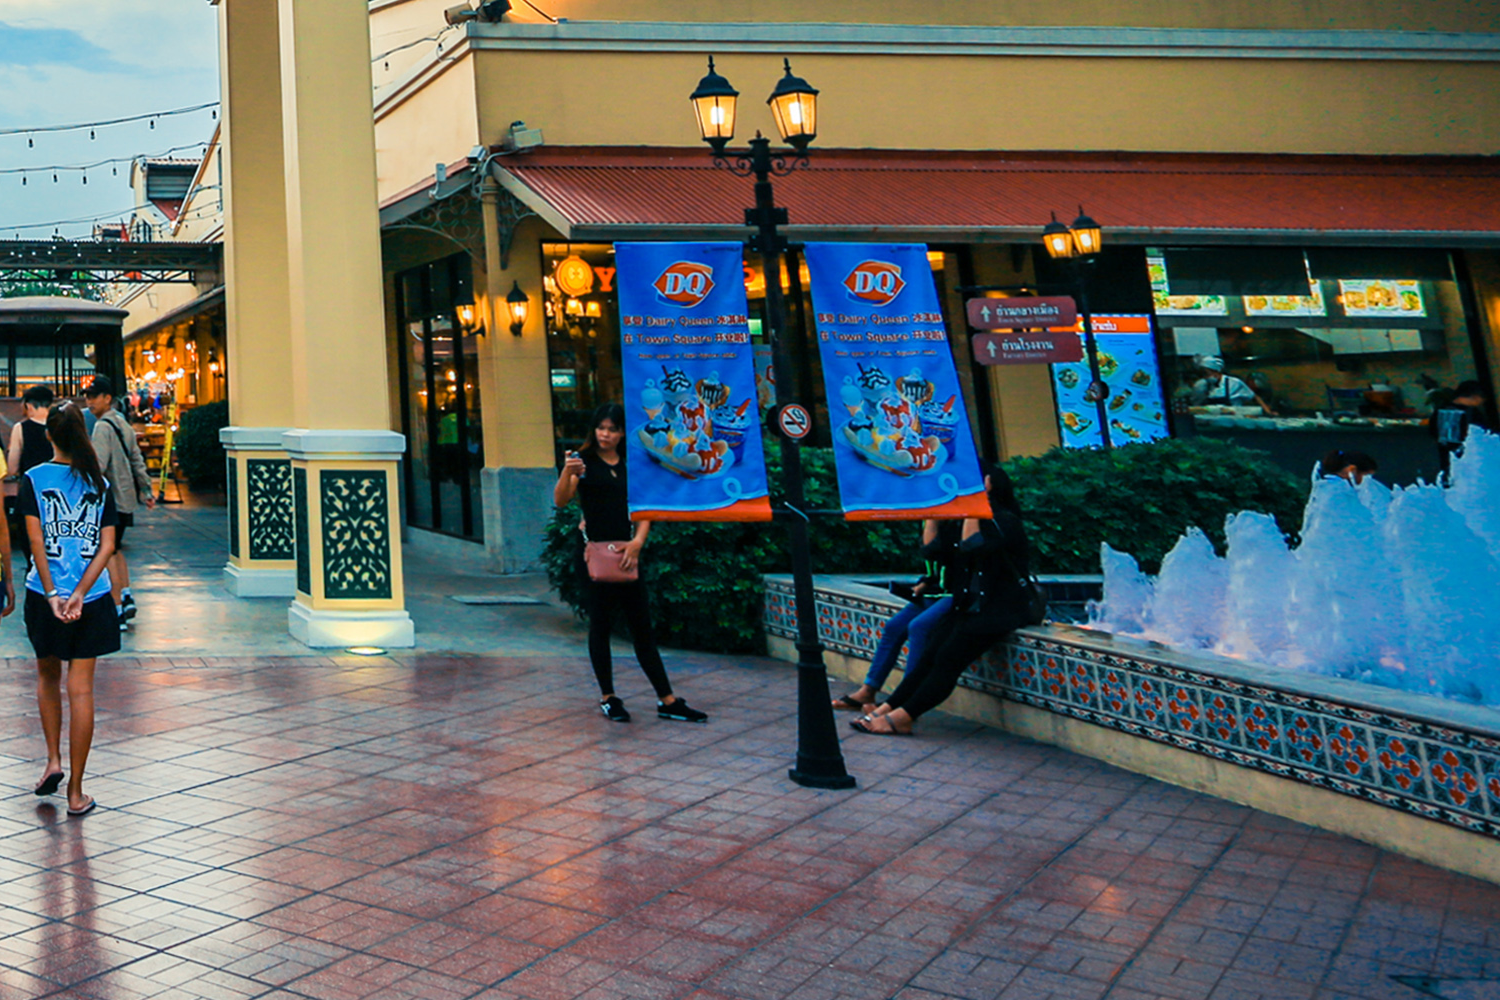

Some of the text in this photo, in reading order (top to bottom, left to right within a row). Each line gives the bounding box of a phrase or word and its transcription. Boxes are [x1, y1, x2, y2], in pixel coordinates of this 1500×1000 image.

[664, 272, 707, 298] DQ
[854, 271, 896, 297] DQ
[646, 316, 676, 327] Dairy
[679, 316, 714, 327] Queen
[838, 314, 867, 325] Dairy
[871, 314, 909, 325] Queen
[637, 334, 670, 344] Town
[673, 334, 712, 346] Square
[832, 331, 863, 341] Town
[866, 331, 909, 343] Square
